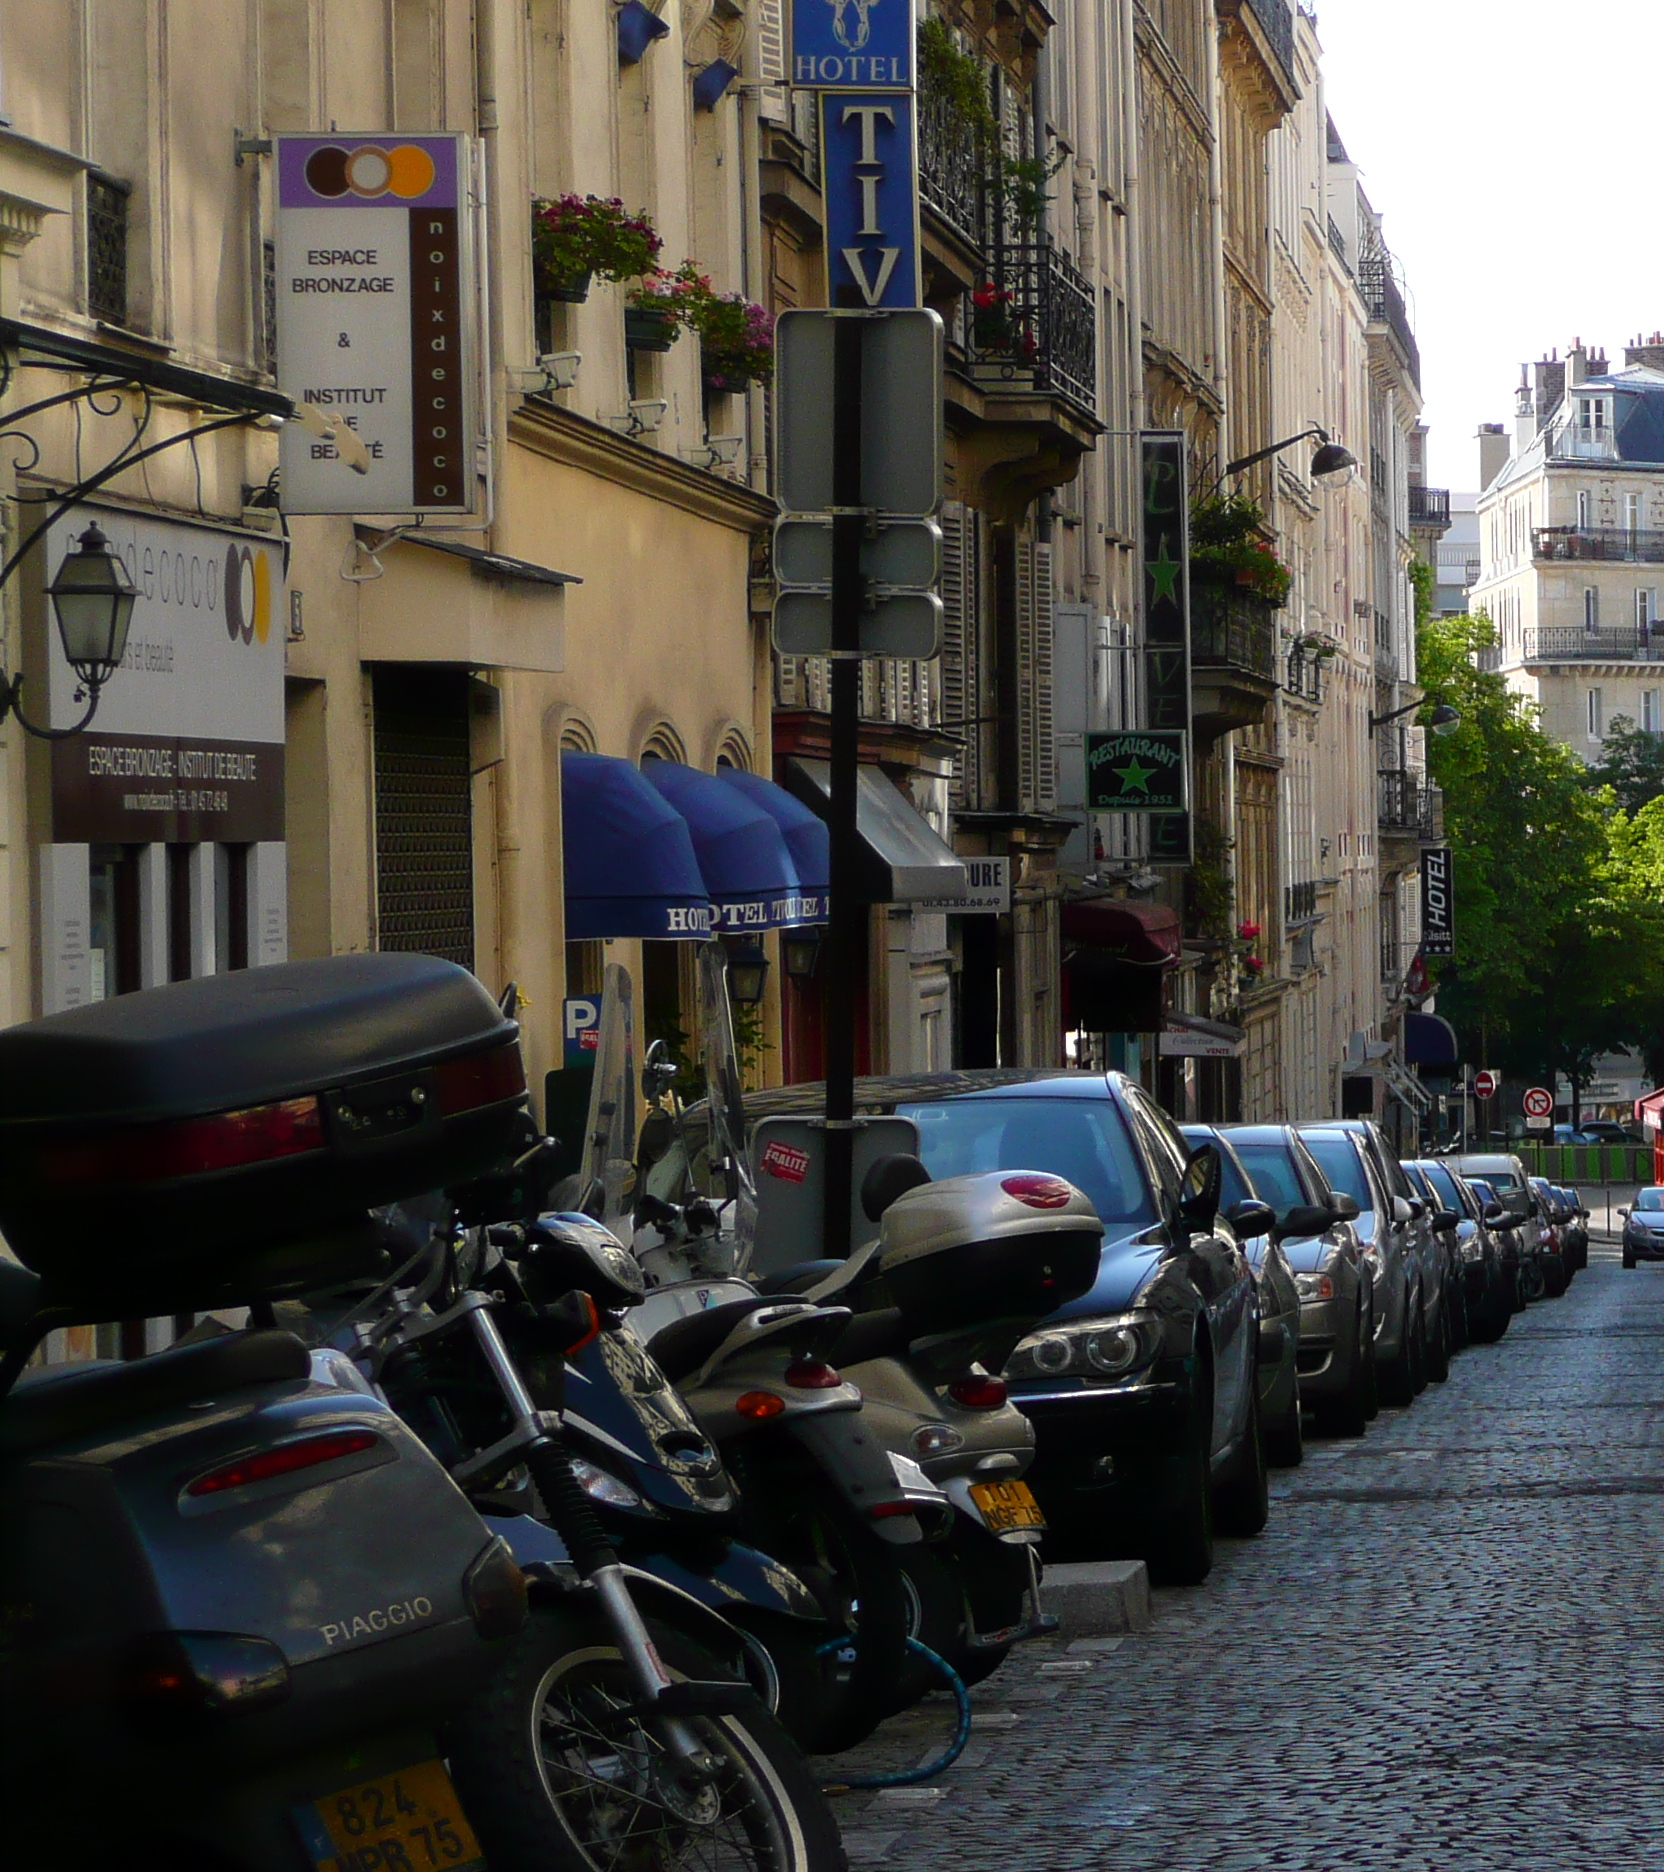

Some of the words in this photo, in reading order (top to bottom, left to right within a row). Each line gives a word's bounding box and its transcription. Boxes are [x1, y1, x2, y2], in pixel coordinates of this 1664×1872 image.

[796, 55, 907, 82] HOTEL
[307, 250, 378, 265] ESPACE
[291, 277, 395, 293] BRONZAGE
[337, 332, 351, 348] &
[429, 221, 448, 497] noixdecoco
[303, 388, 388, 404] INSTITUT
[310, 441, 383, 459] BEÉ
[89, 745, 124, 775] ESPACE
[125, 748, 173, 777] BRONZAGE
[178, 750, 213, 779] INSTITUT
[214, 752, 226, 779] DE
[1090, 737, 1181, 770] RESTAURANT
[1097, 795, 1142, 807] Depuis
[968, 863, 1002, 887] URE
[1427, 851, 1446, 927] HOTEL
[566, 1001, 597, 1039] P
[984, 1483, 1021, 1502] 101
[319, 1596, 432, 1645] PIAGGIO
[338, 1778, 418, 1837] 824
[409, 1816, 464, 1866] 75
